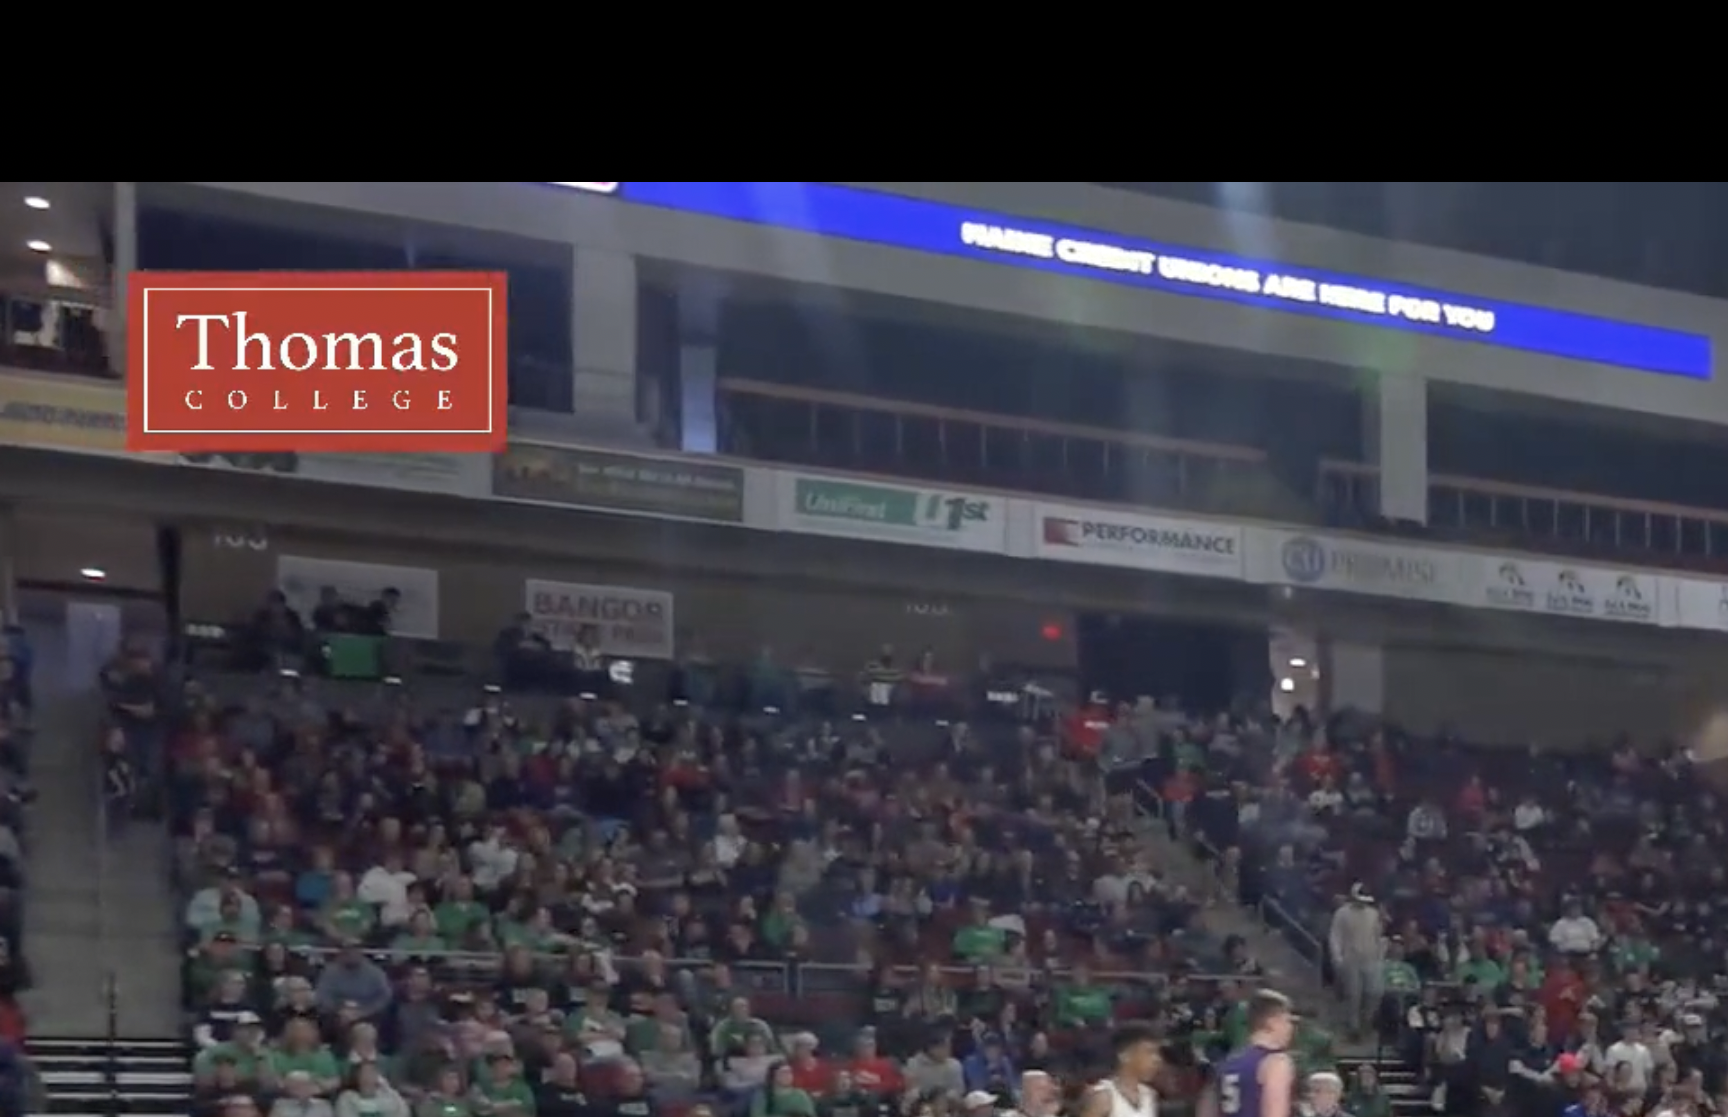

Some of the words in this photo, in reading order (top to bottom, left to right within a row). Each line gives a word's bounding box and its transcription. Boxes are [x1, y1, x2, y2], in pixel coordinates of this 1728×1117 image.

[1441, 302, 1496, 333] YOU
[1081, 521, 1236, 556] PERFORMANCE
[1221, 1073, 1241, 1115] 5
